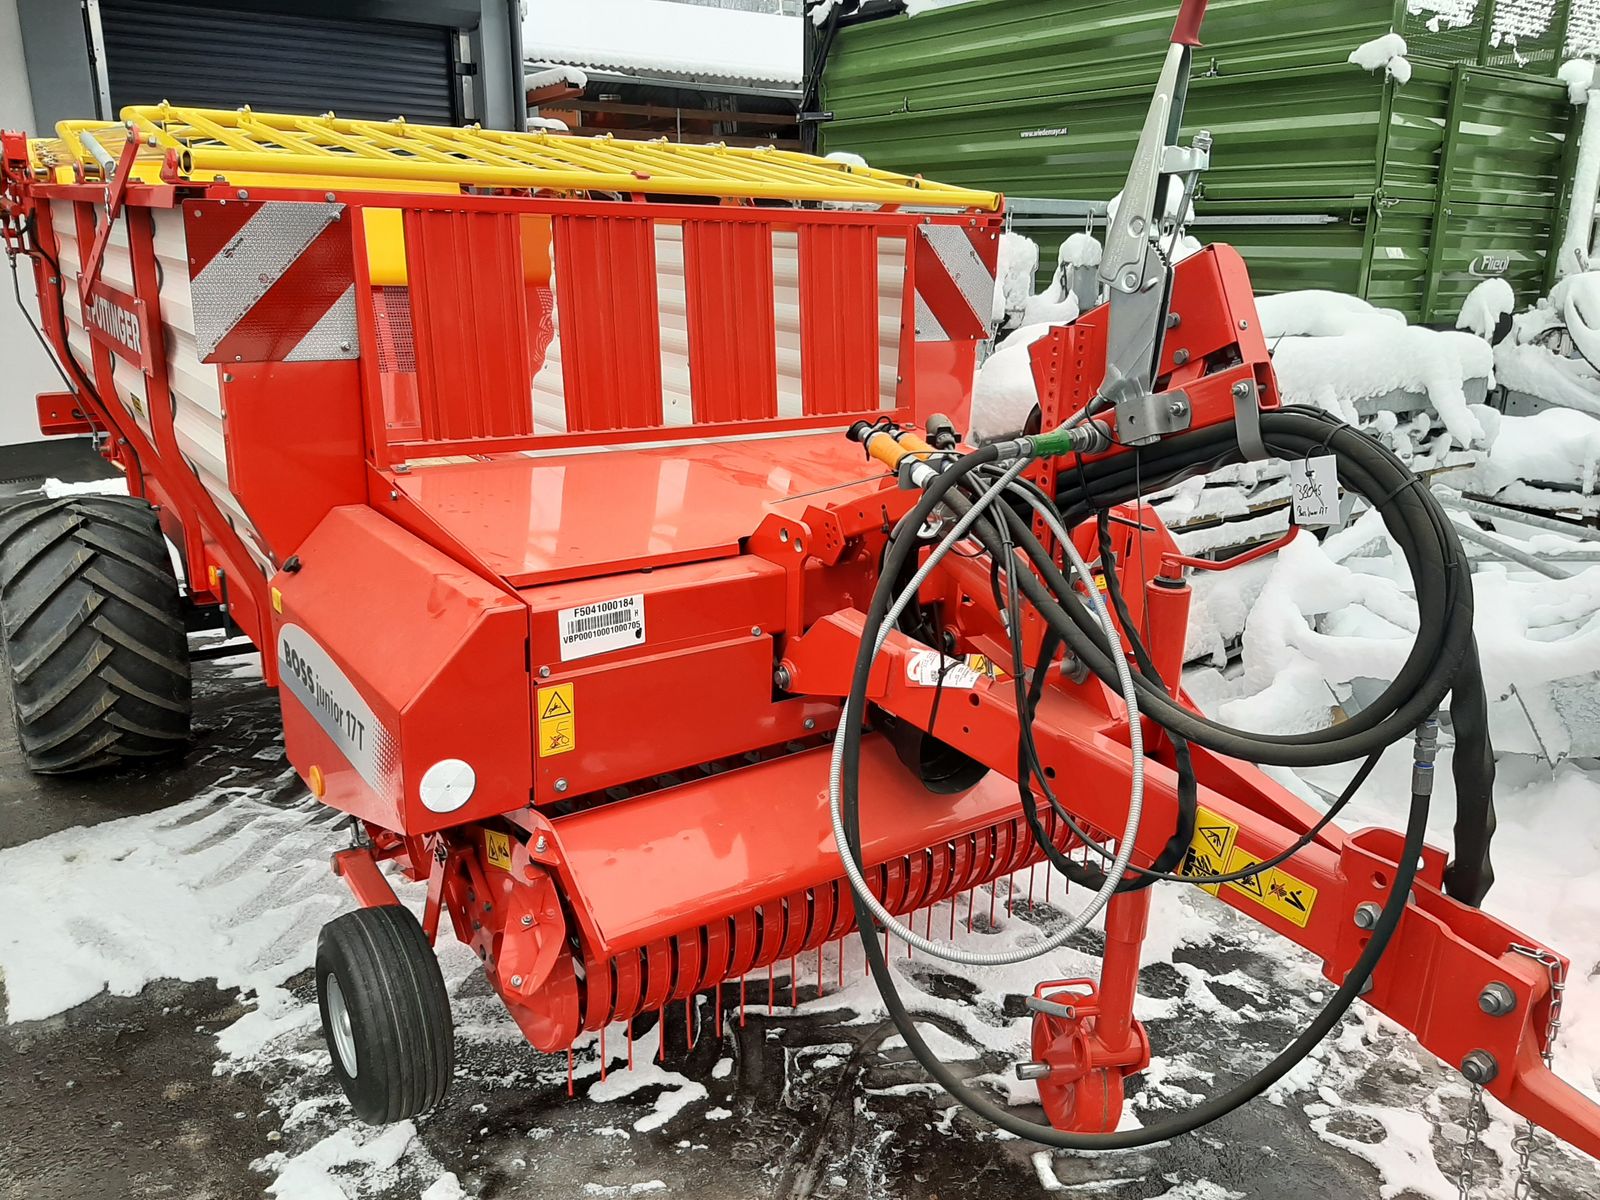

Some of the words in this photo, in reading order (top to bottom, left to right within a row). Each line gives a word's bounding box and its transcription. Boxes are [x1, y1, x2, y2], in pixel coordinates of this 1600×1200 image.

[1481, 255, 1510, 274] Fliegl
[574, 597, 634, 618] F5041000184
[563, 620, 641, 644] VBP00010001000705
[283, 638, 315, 694] BOSS
[316, 674, 344, 728] junior
[346, 710, 366, 751] 17T
